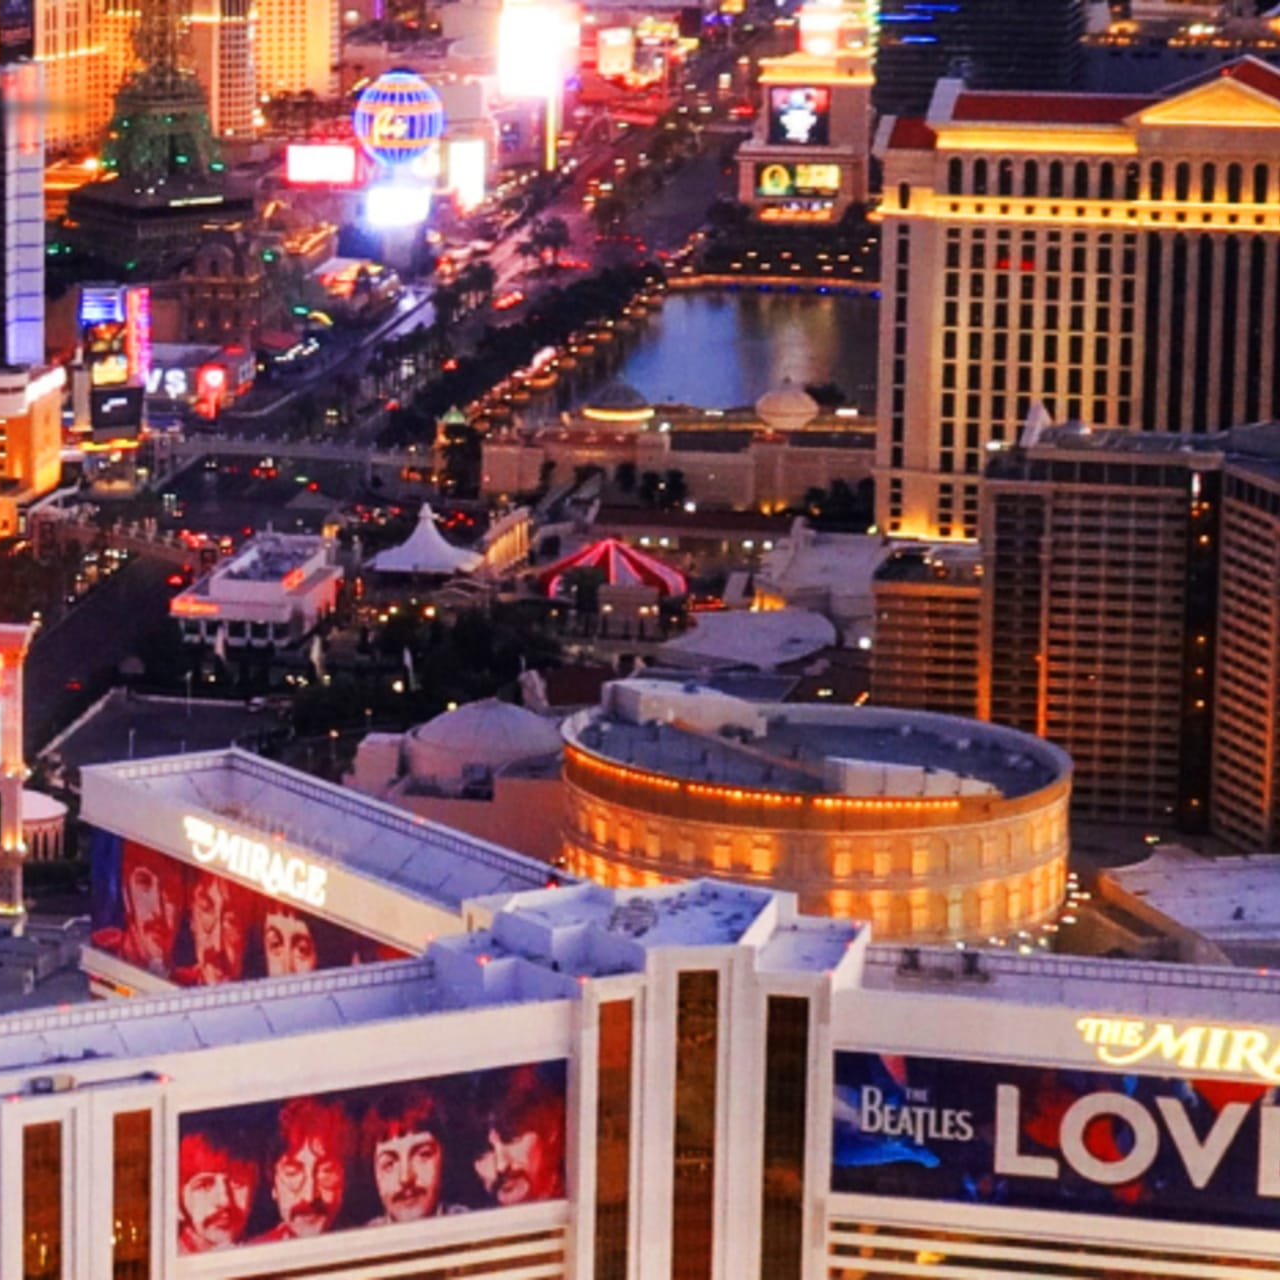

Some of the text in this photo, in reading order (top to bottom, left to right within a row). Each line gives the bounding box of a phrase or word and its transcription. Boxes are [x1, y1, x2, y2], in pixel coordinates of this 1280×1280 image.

[192, 829, 328, 907] MIRAGE
[1077, 1018, 1145, 1047] THE
[906, 1088, 929, 1103] THE
